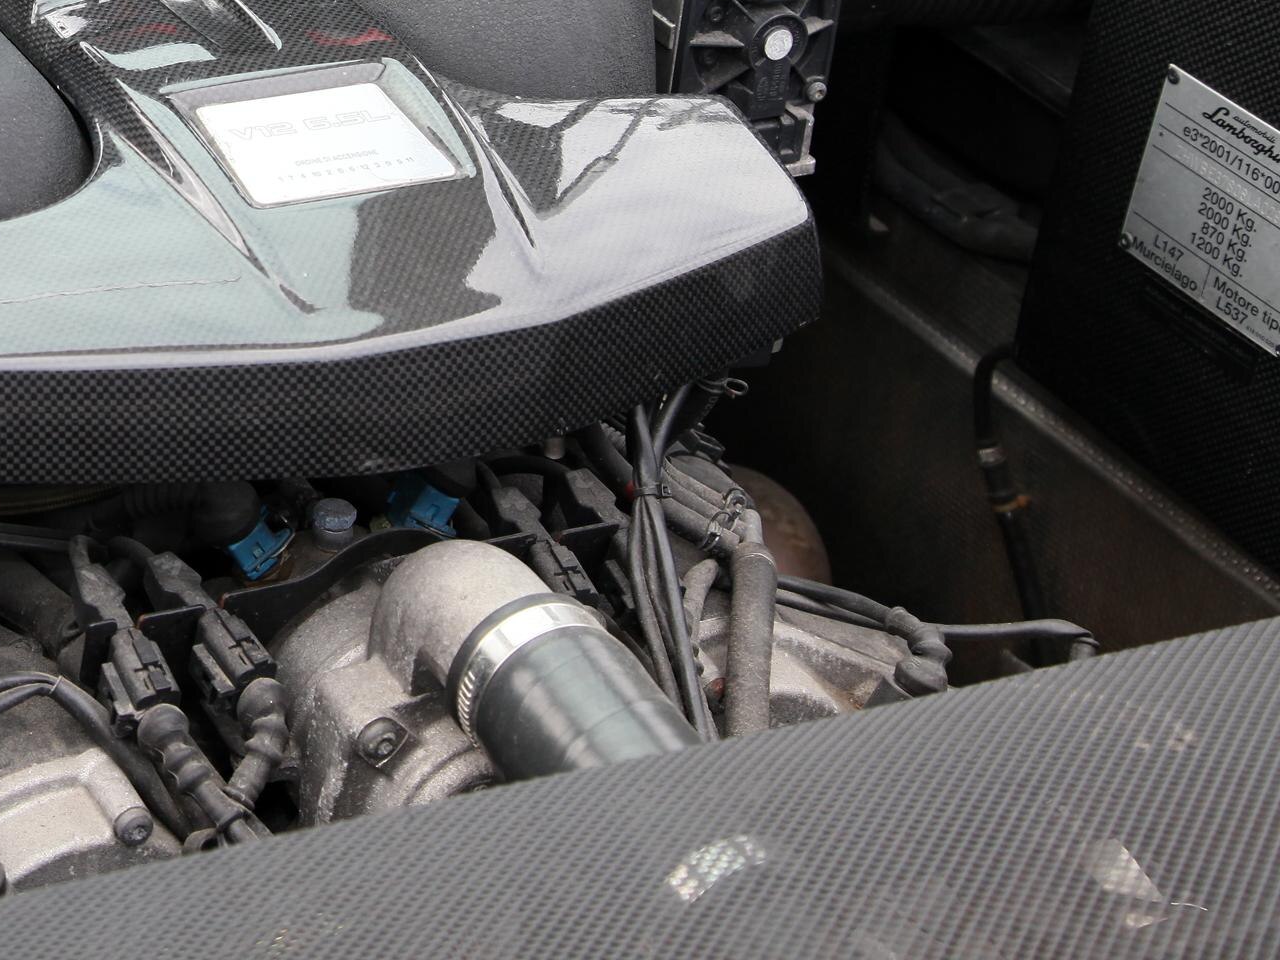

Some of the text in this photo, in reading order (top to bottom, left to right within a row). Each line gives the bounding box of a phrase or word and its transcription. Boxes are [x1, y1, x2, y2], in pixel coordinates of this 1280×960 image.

[229, 121, 298, 141] V12
[1198, 202, 1253, 248] 2000 Kg.
[1203, 187, 1257, 233] 2000 Kg.
[1153, 234, 1184, 262] L147
[1190, 232, 1243, 278] 1200 Kg.
[1200, 222, 1248, 263] 870 Kg.
[1131, 236, 1198, 292] Murcielago
[1213, 276, 1259, 316] Motore
[1216, 296, 1249, 324] L537
